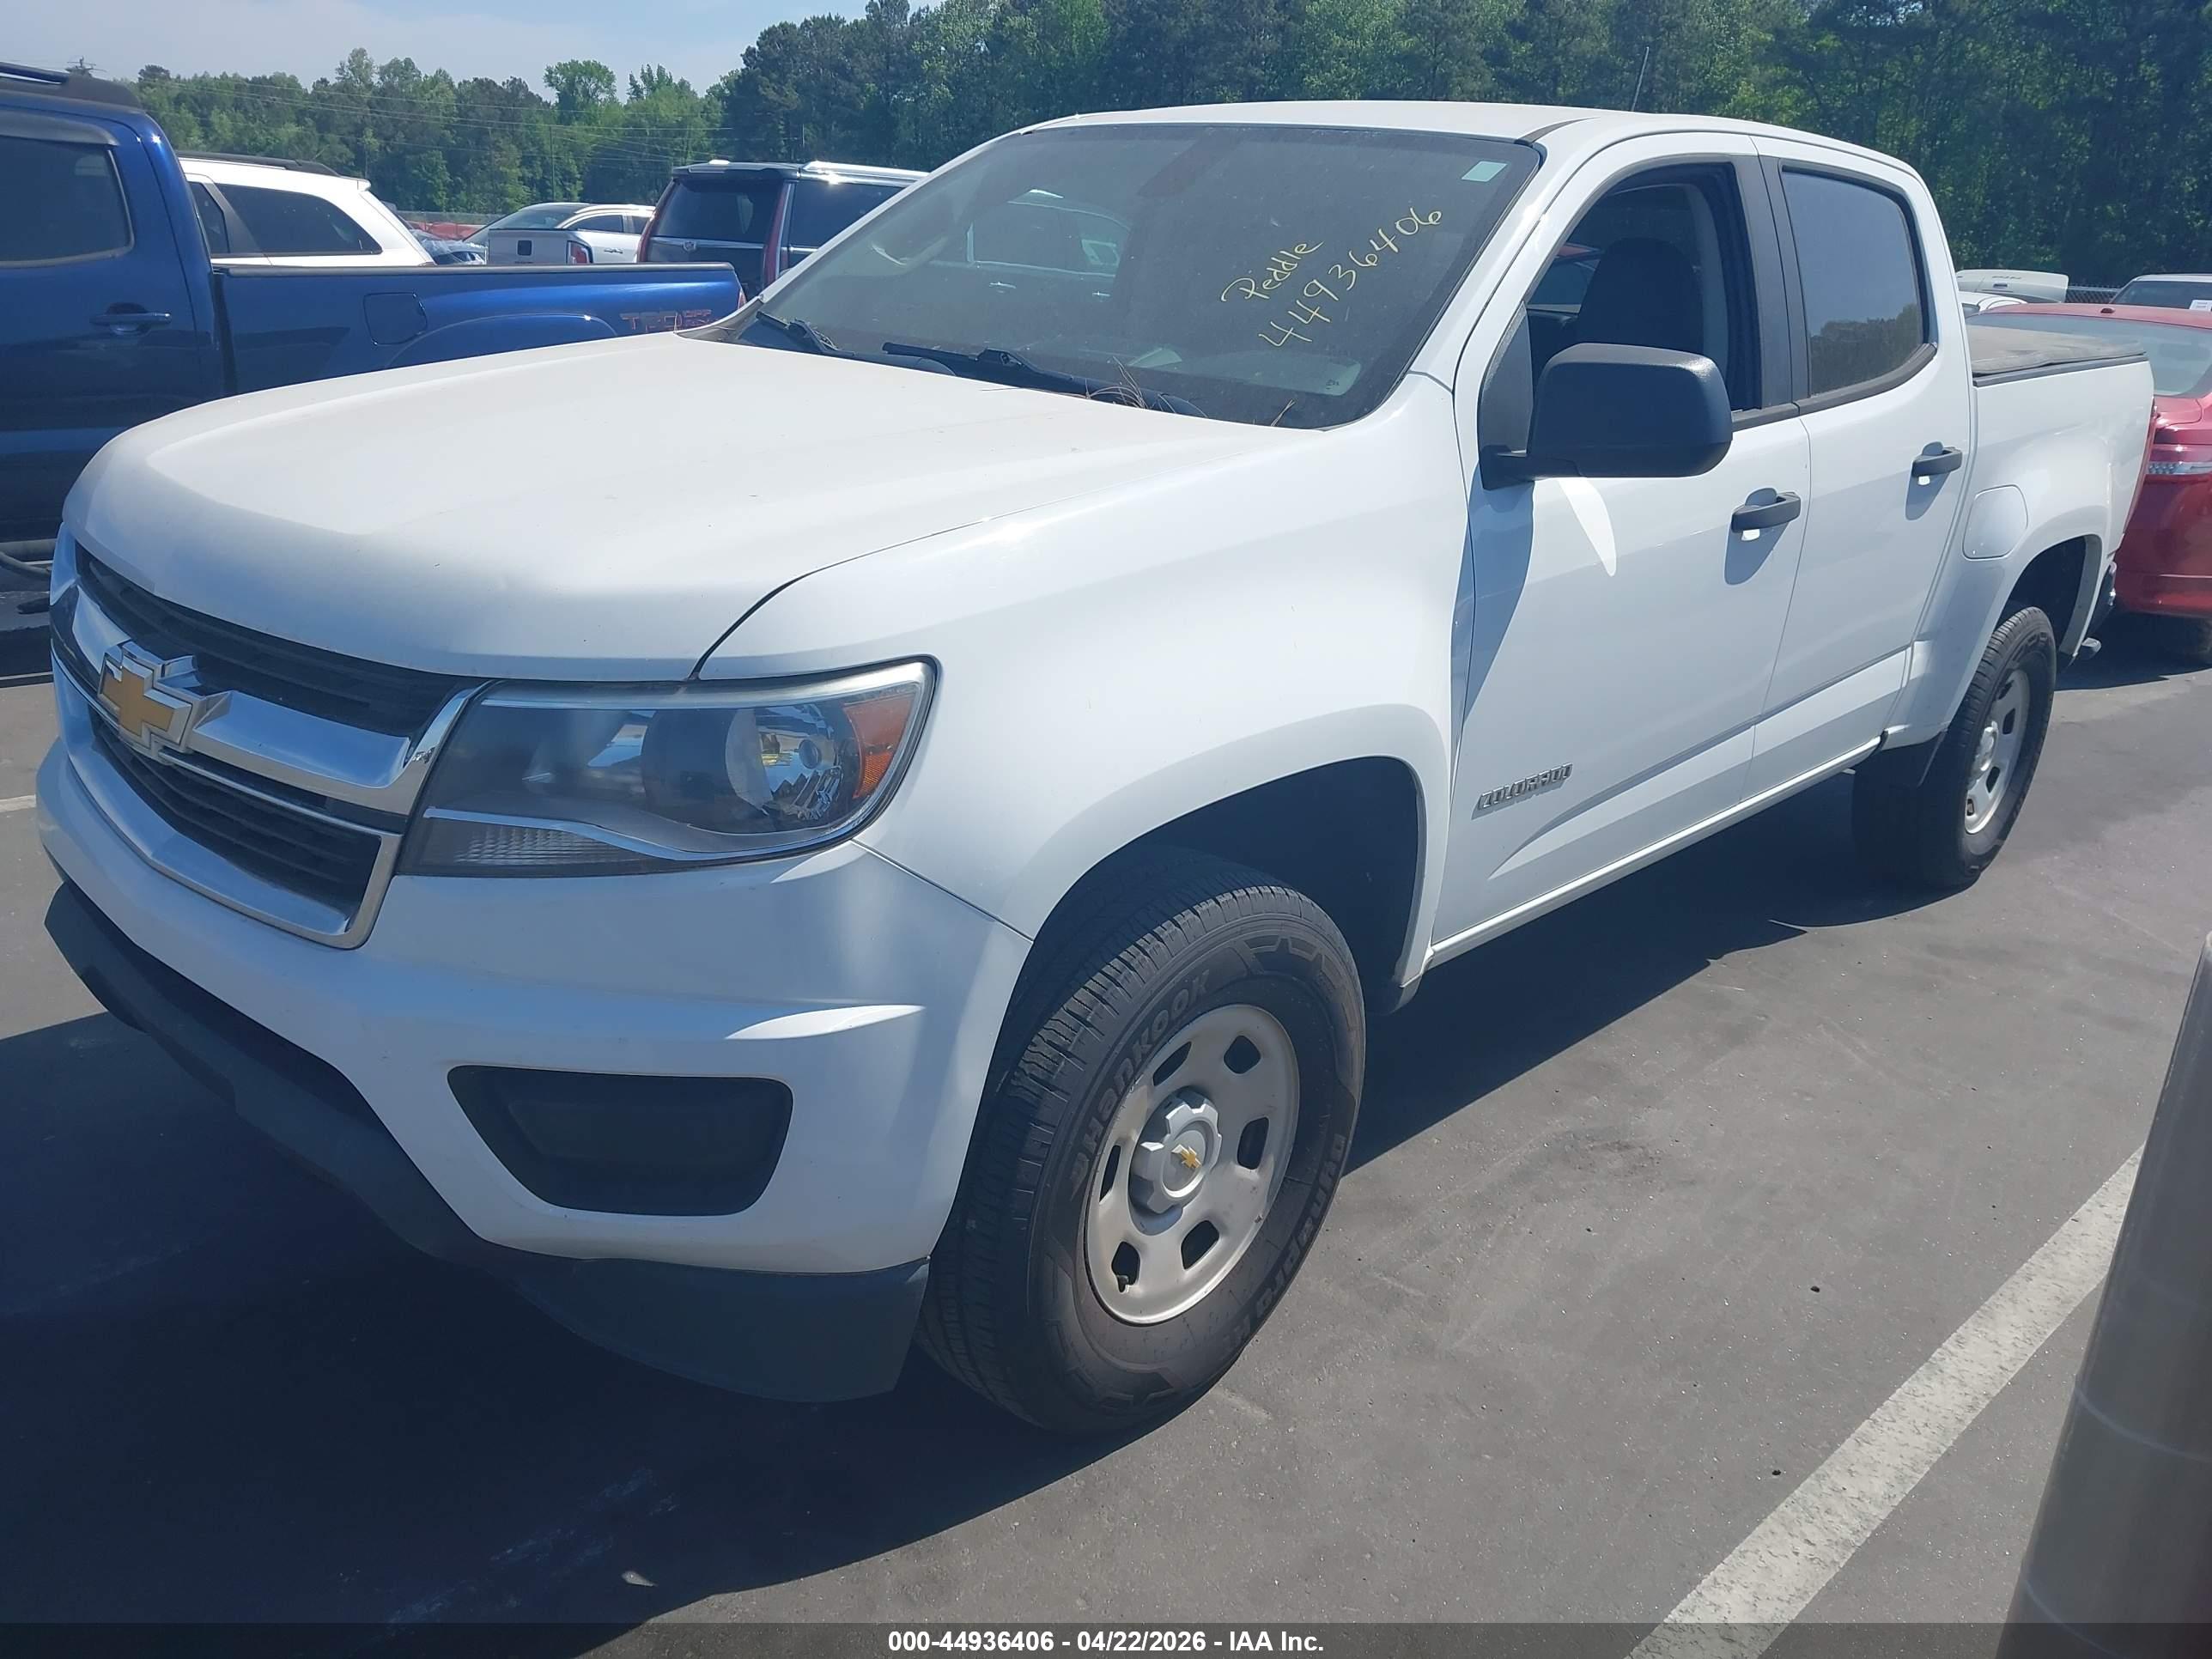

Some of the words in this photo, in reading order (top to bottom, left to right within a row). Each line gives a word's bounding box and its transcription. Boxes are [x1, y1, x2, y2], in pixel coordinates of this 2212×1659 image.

[1220, 240, 1325, 302] Peddle
[1257, 207, 1443, 347] 44936406
[1477, 762, 1573, 811] COLORADO
